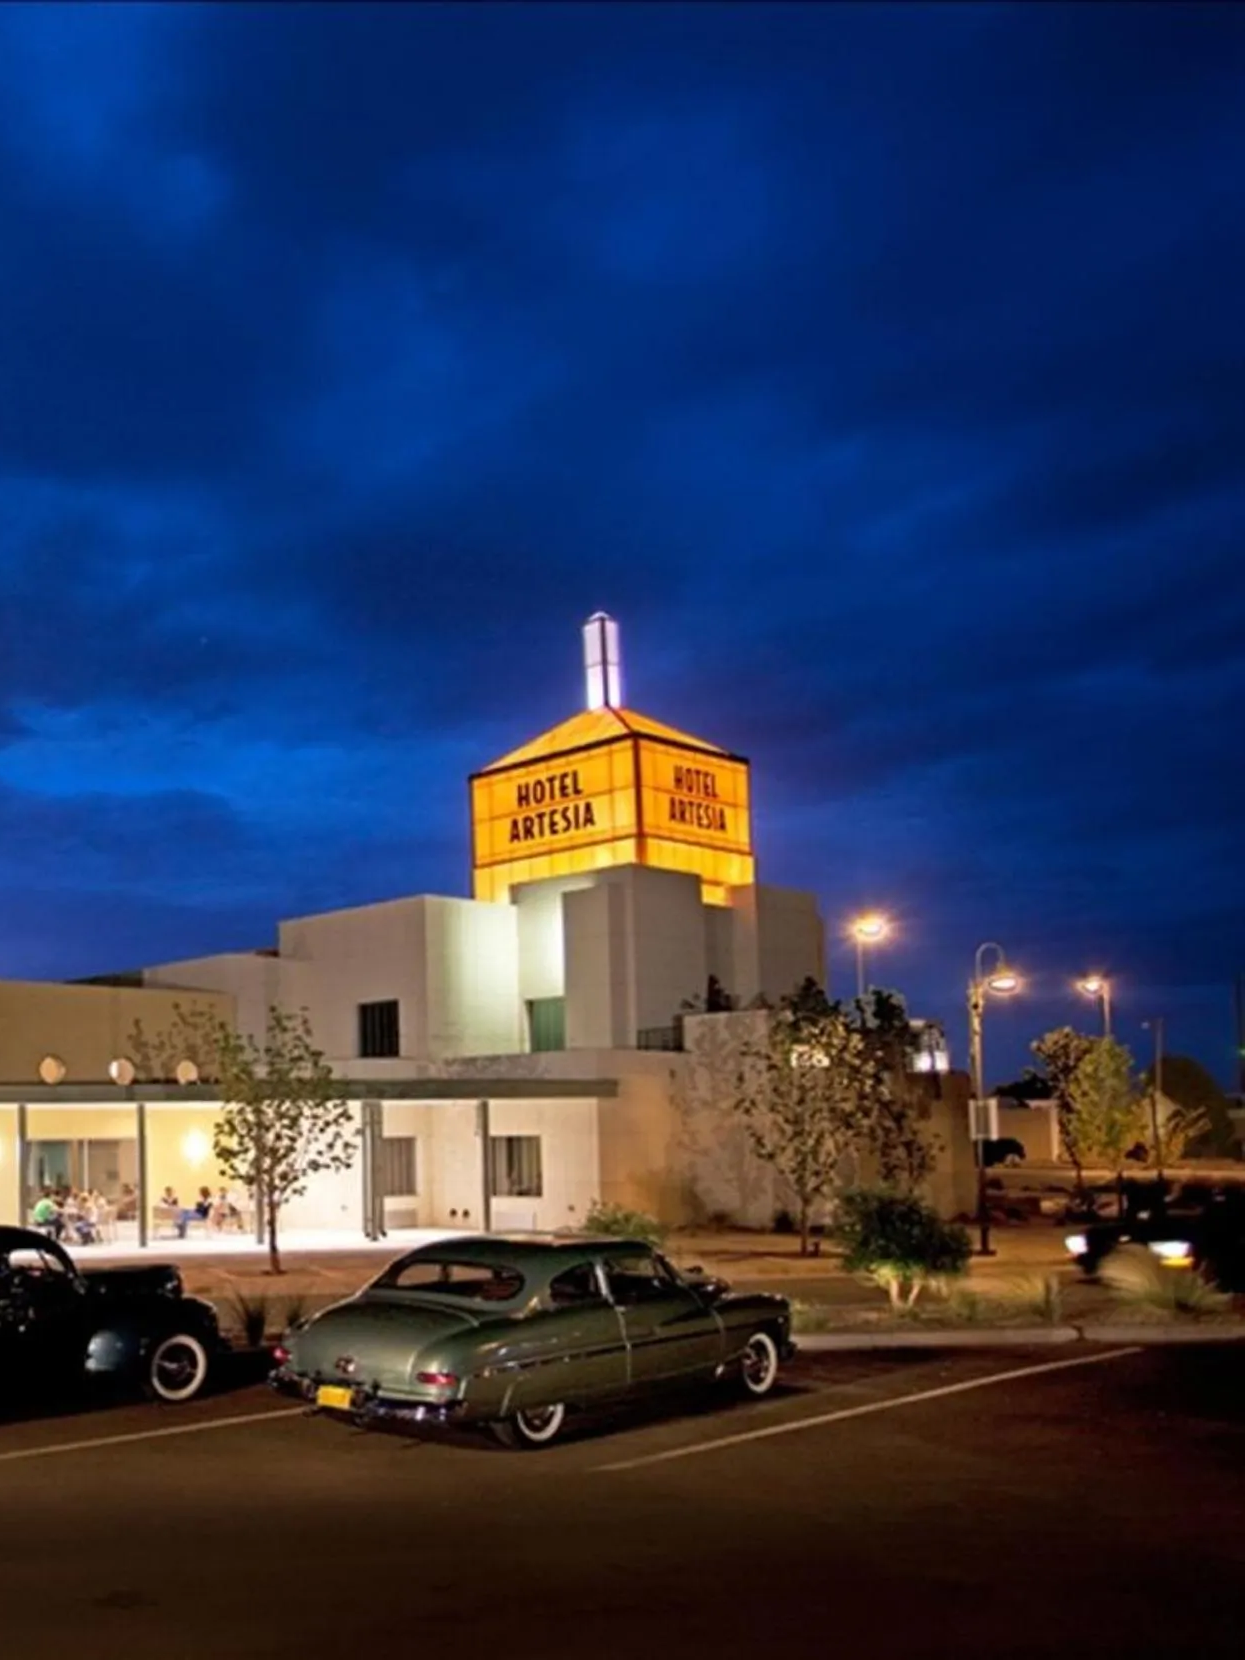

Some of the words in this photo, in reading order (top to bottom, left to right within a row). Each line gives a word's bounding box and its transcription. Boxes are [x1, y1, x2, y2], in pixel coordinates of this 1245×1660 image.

[517, 770, 583, 809] HOTEL
[674, 765, 719, 798] HOTEL
[509, 801, 596, 844] ARTESIA
[669, 796, 728, 832] ARTESIA
